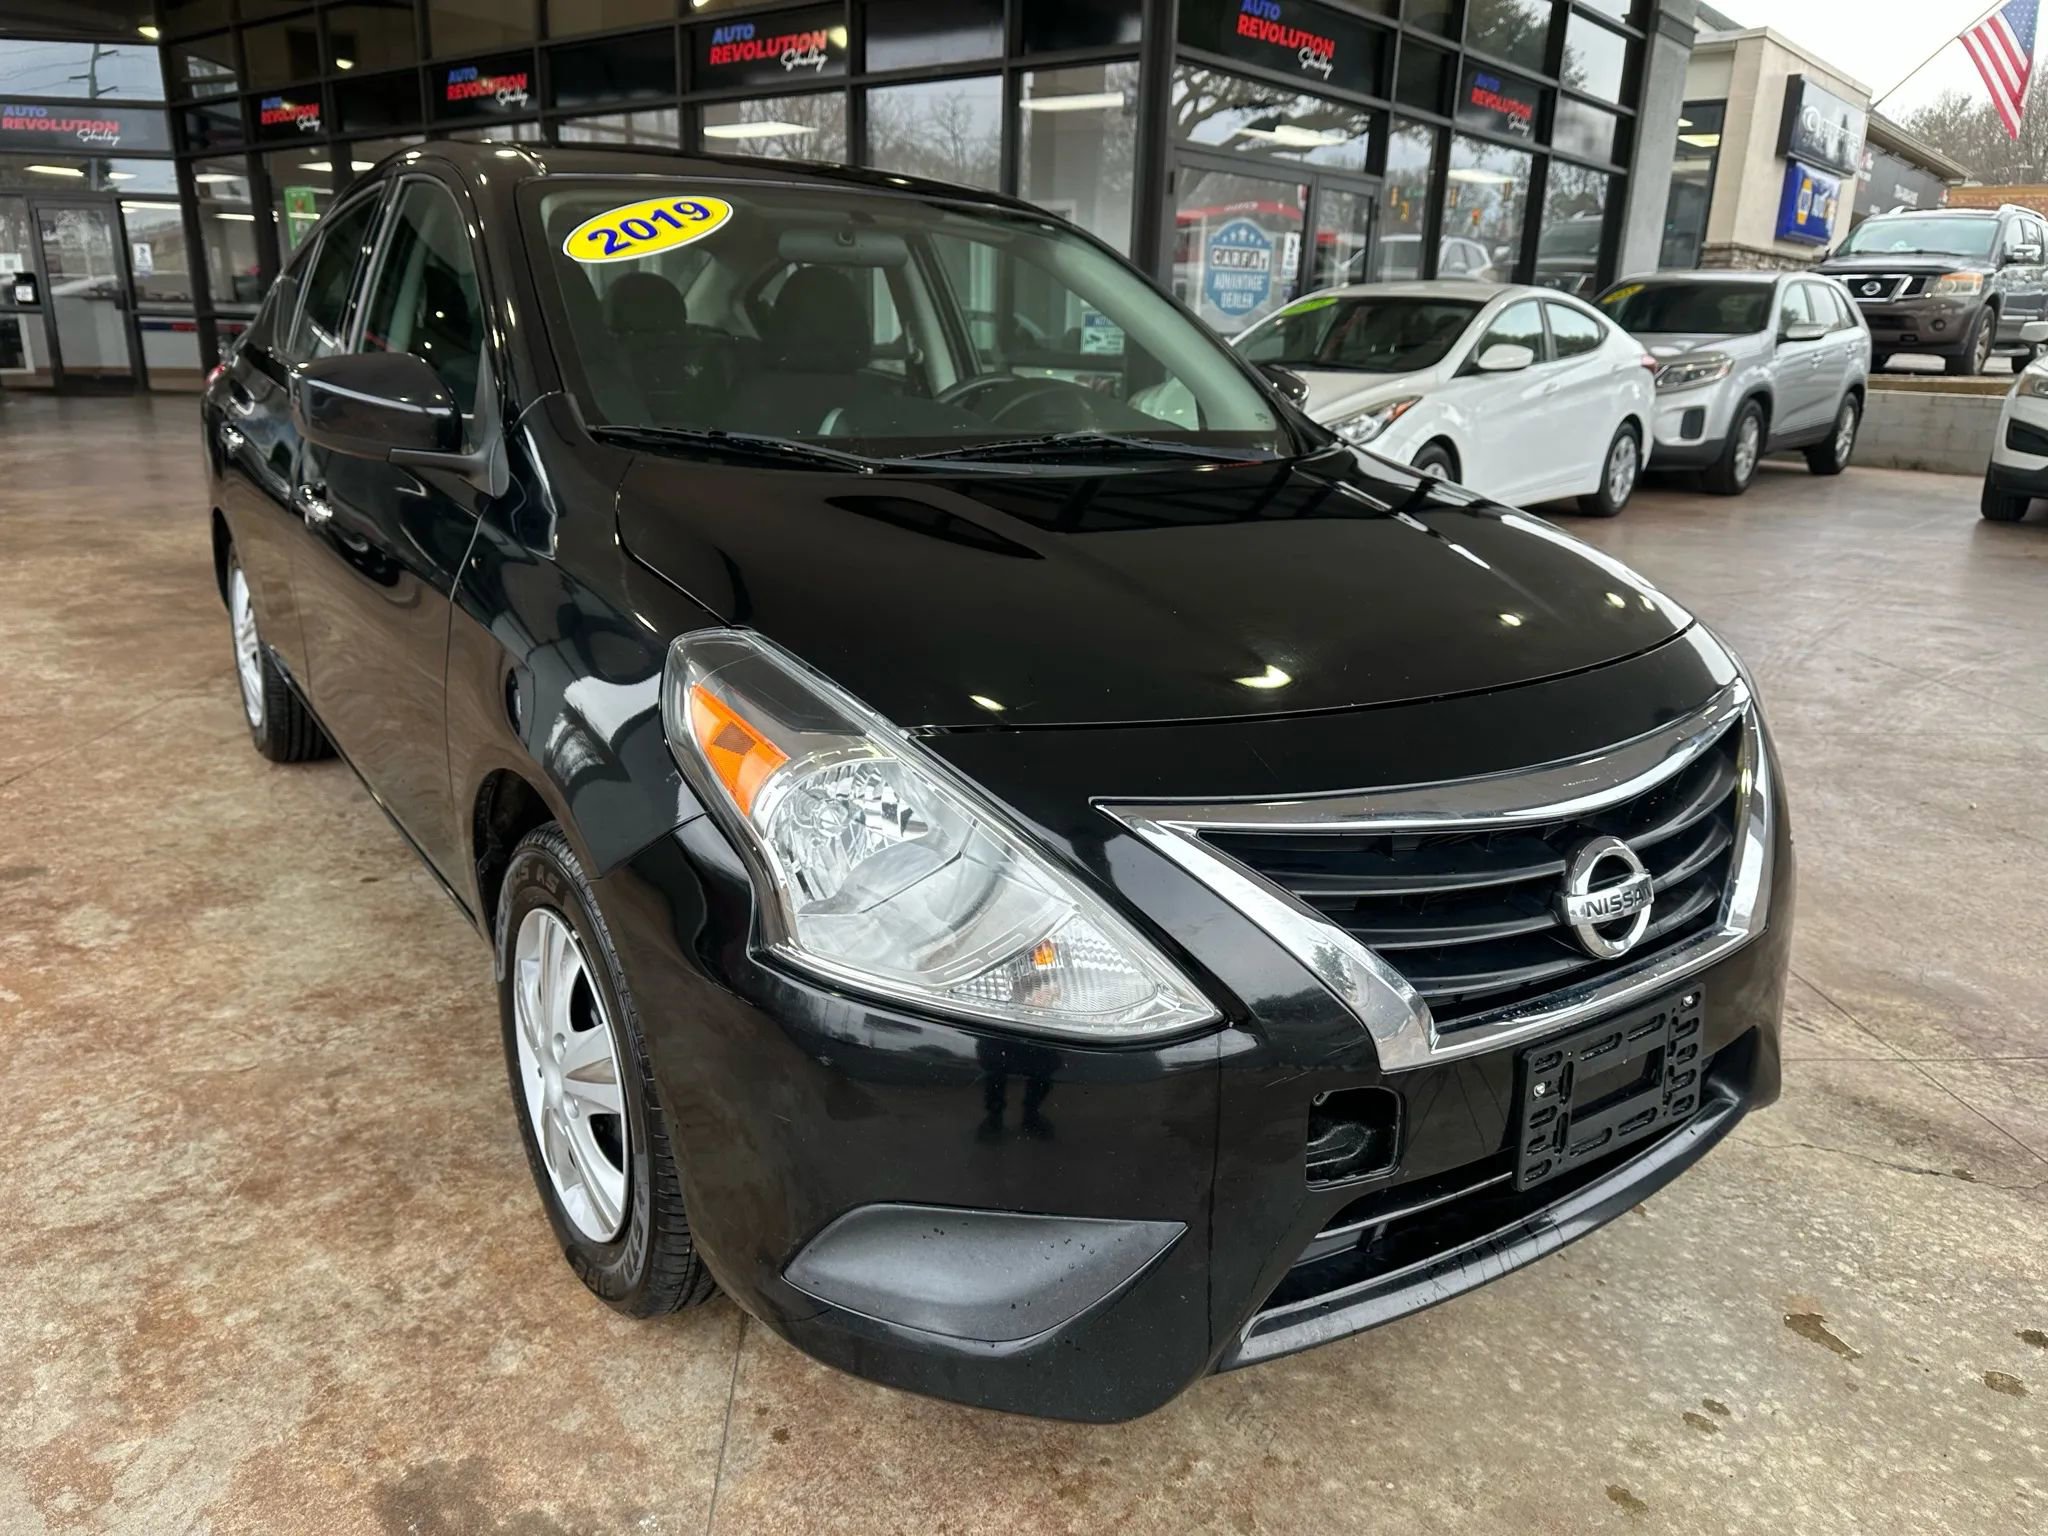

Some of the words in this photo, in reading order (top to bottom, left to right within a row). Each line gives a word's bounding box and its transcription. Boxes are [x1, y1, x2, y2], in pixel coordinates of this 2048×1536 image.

[1240, 0, 1281, 20] AUTO
[711, 23, 755, 45] AUTO
[1237, 13, 1336, 59] REVOLUTION
[709, 29, 828, 65] REVOLUTION
[447, 66, 478, 84] AUTO
[447, 72, 527, 101] REVOLUTION
[4, 105, 48, 117] AUTO
[1471, 87, 1533, 121] REVOLUTION
[2, 117, 119, 131] REVOLUTION
[76, 128, 121, 147] Shelby
[587, 201, 711, 255] 2019
[1585, 886, 1652, 918] NISSAN
